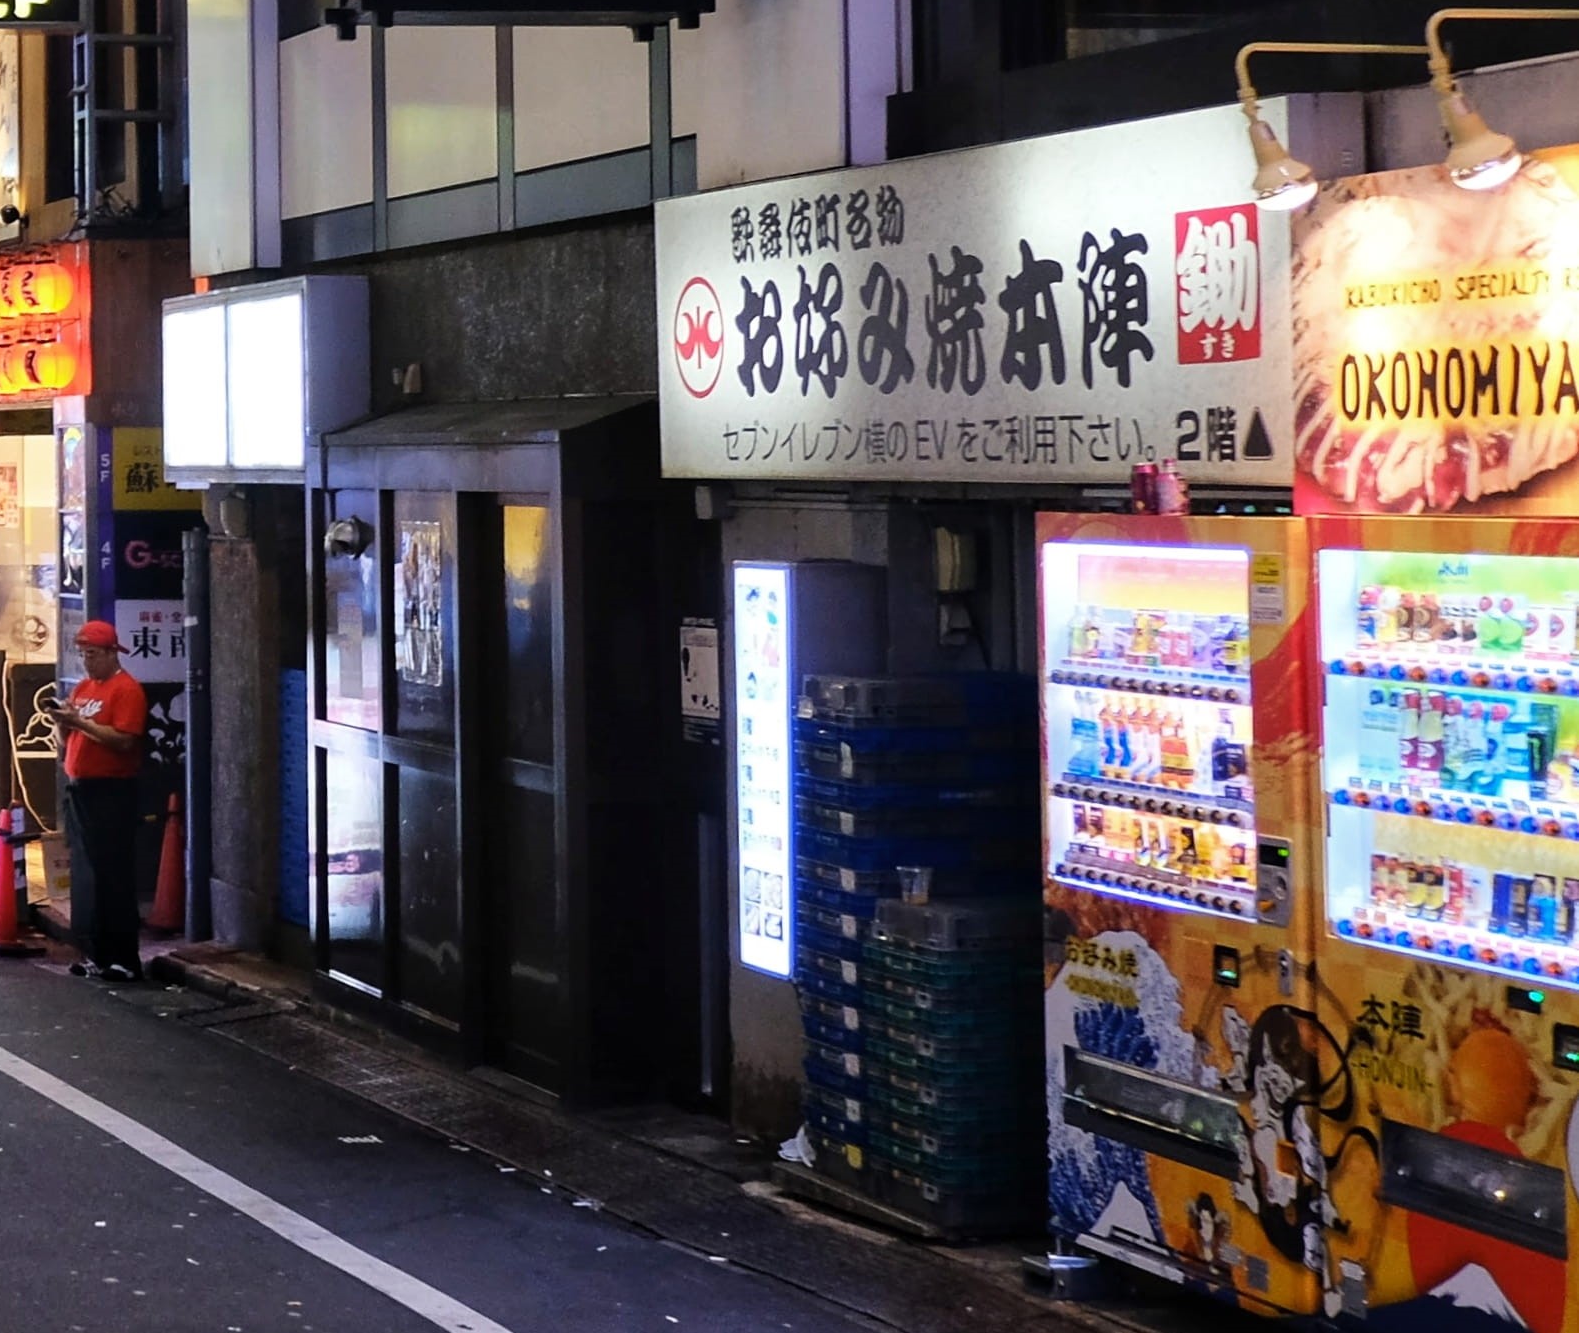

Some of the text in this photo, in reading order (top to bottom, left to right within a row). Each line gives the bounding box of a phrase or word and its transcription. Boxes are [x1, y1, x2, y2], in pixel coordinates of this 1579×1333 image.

[730, 183, 905, 265] 歌舞伎町名物
[1175, 210, 1259, 334] 鋤
[735, 225, 1156, 399] お好み焼本陣
[1200, 330, 1236, 360] すき
[722, 406, 1239, 464] セブンイレブン横の EV をご利用下さい。 2階
[1063, 935, 1139, 979] お好み焼
[1355, 993, 1425, 1042] 本陣
